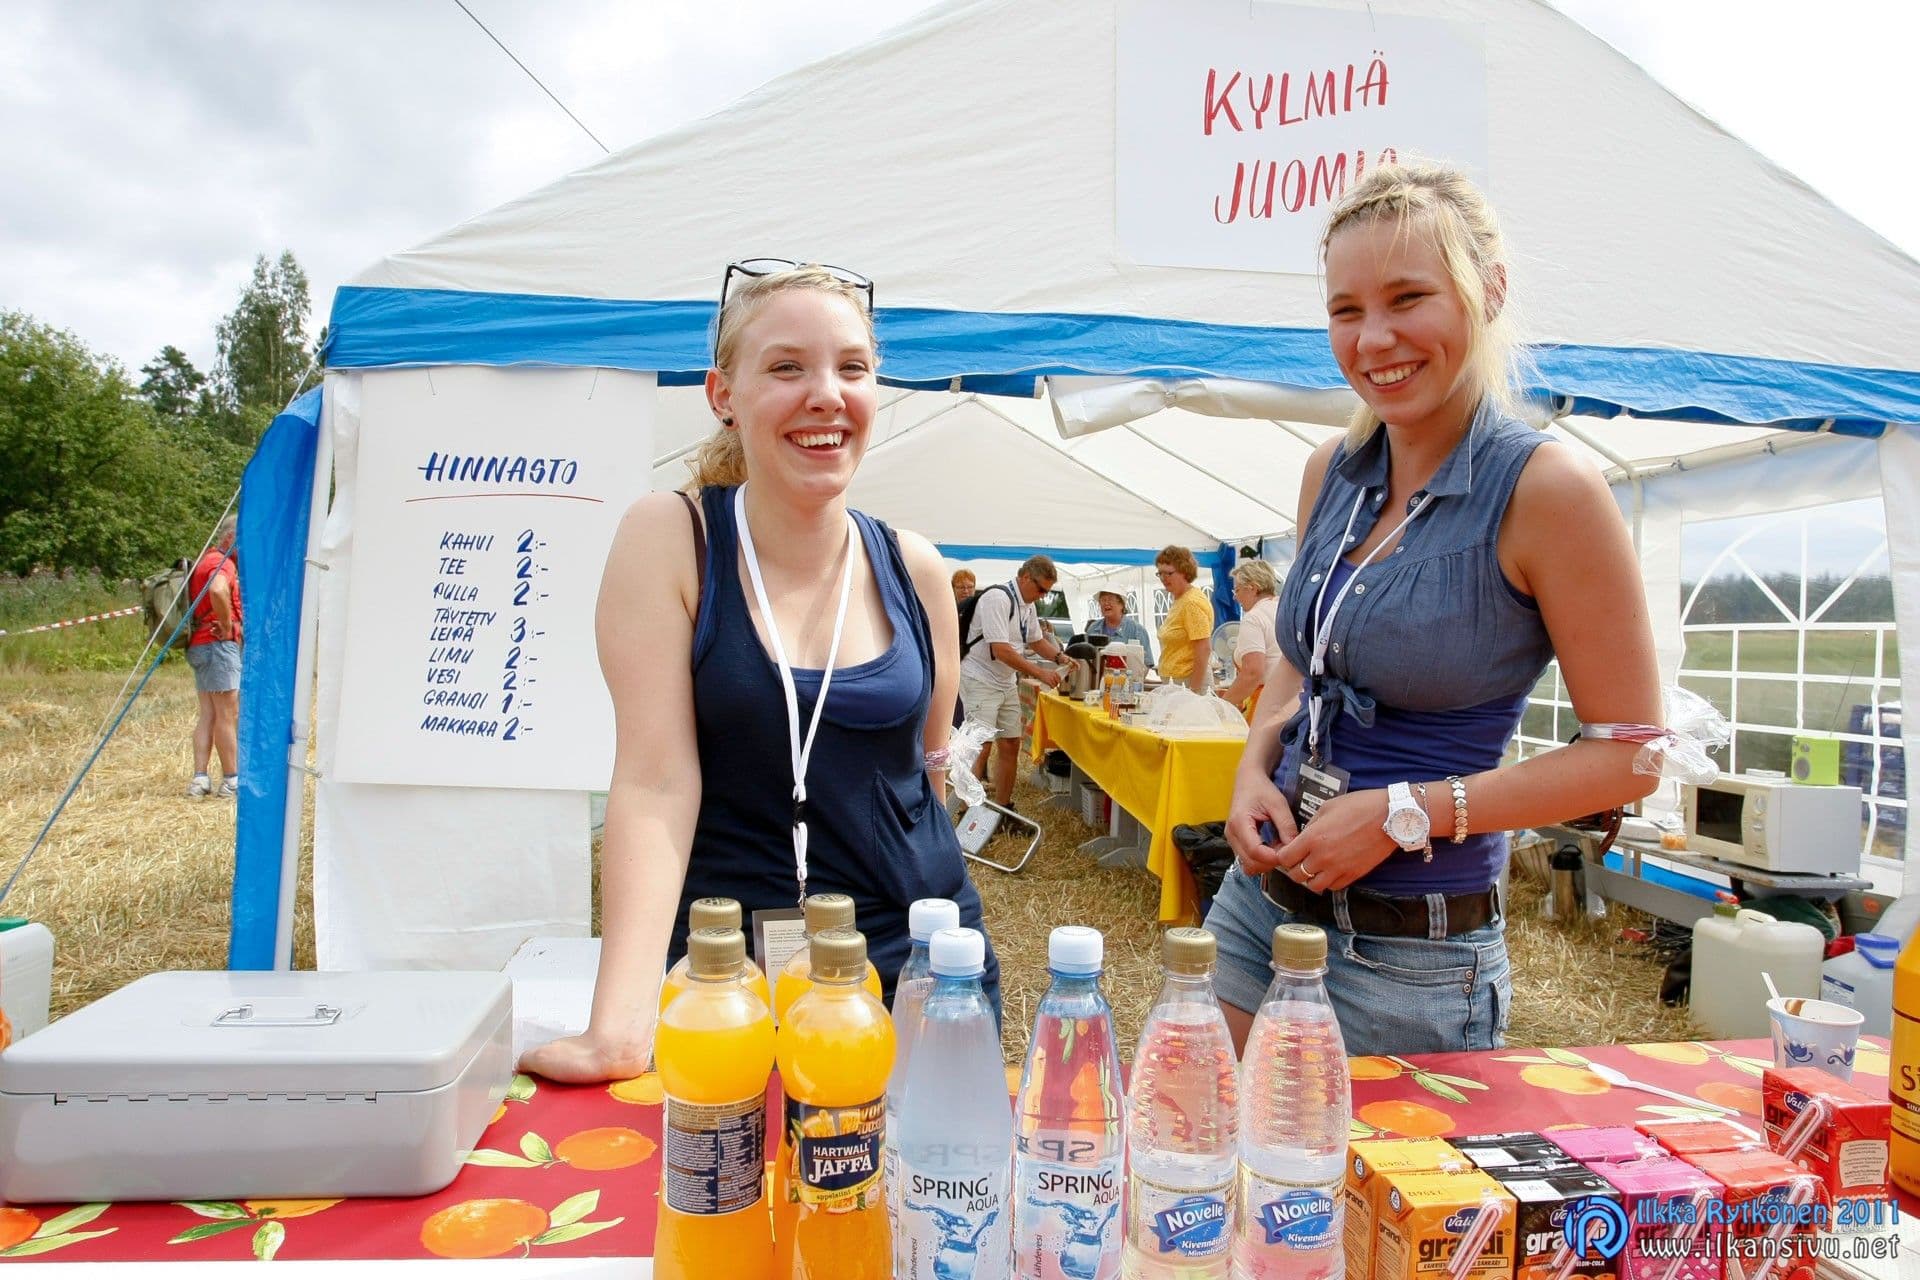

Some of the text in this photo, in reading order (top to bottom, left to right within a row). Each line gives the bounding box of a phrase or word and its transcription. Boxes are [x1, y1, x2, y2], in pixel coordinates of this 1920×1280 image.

[1204, 50, 1389, 135] KYLMIÄ
[417, 452, 577, 484] HINNASTO
[439, 532, 494, 551] KAHVI
[439, 558, 467, 575] TEE
[433, 583, 479, 601] PULLA
[434, 606, 497, 626] TÄYTETTY
[428, 646, 474, 664] LIMU
[427, 668, 461, 684] VESI
[424, 690, 488, 709] GRANDI
[421, 715, 498, 737] MAKKARA
[813, 1142, 870, 1157] HARTWALL
[808, 1154, 873, 1184] JAFFA
[912, 1174, 989, 1200] SPRING
[1038, 1170, 1113, 1194] SPRING
[966, 1193, 999, 1213] AQUA
[1092, 1185, 1120, 1206] AQUA
[1165, 1203, 1224, 1233] Novelle
[1271, 1199, 1331, 1225] Novelle
[1447, 1216, 1474, 1227] Vali
[1418, 1230, 1504, 1262] gradi
